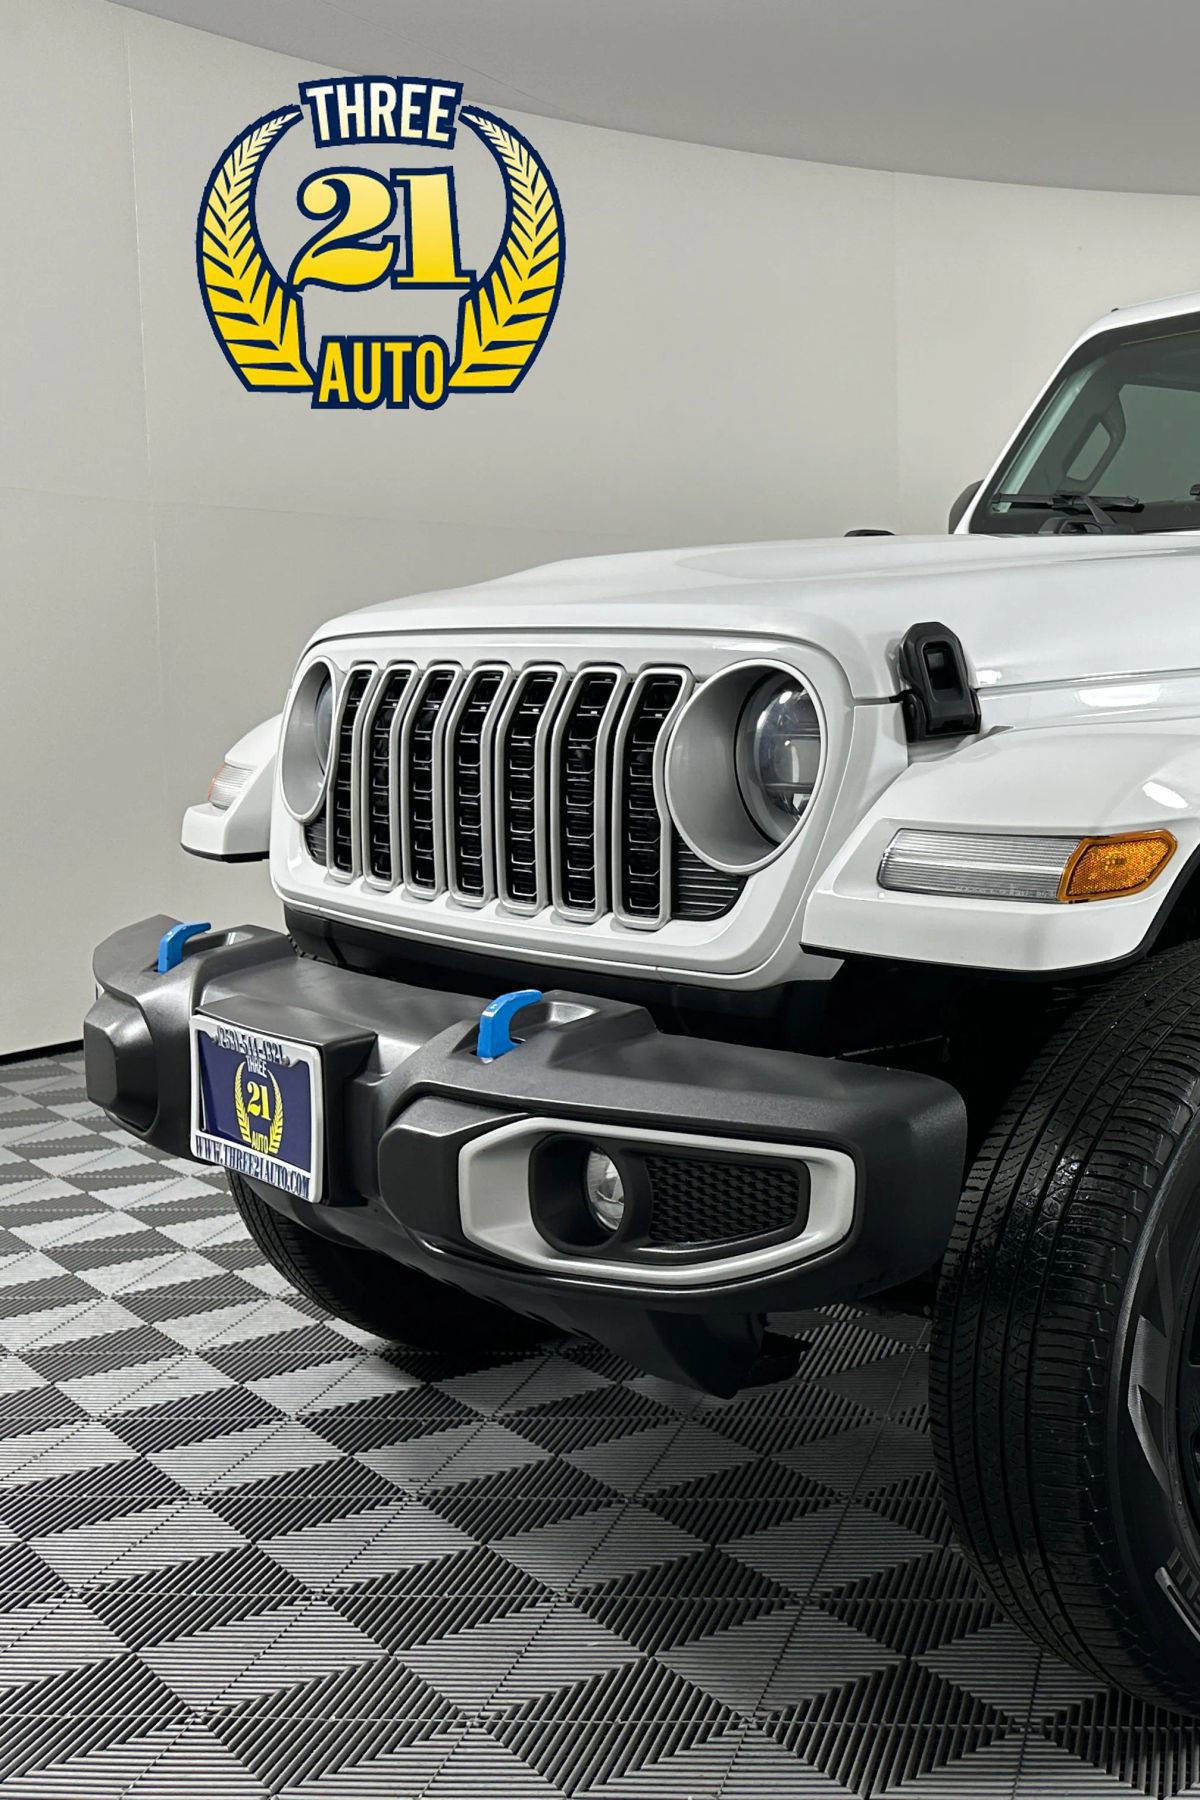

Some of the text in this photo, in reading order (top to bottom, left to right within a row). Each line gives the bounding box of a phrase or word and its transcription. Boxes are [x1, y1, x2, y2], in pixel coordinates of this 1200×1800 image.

[245, 1054, 268, 1078] THREE
[247, 1081, 271, 1121] 21
[251, 1130, 269, 1155] AUTO
[195, 1135, 311, 1200] WWW.THREE21AUTO.COM
